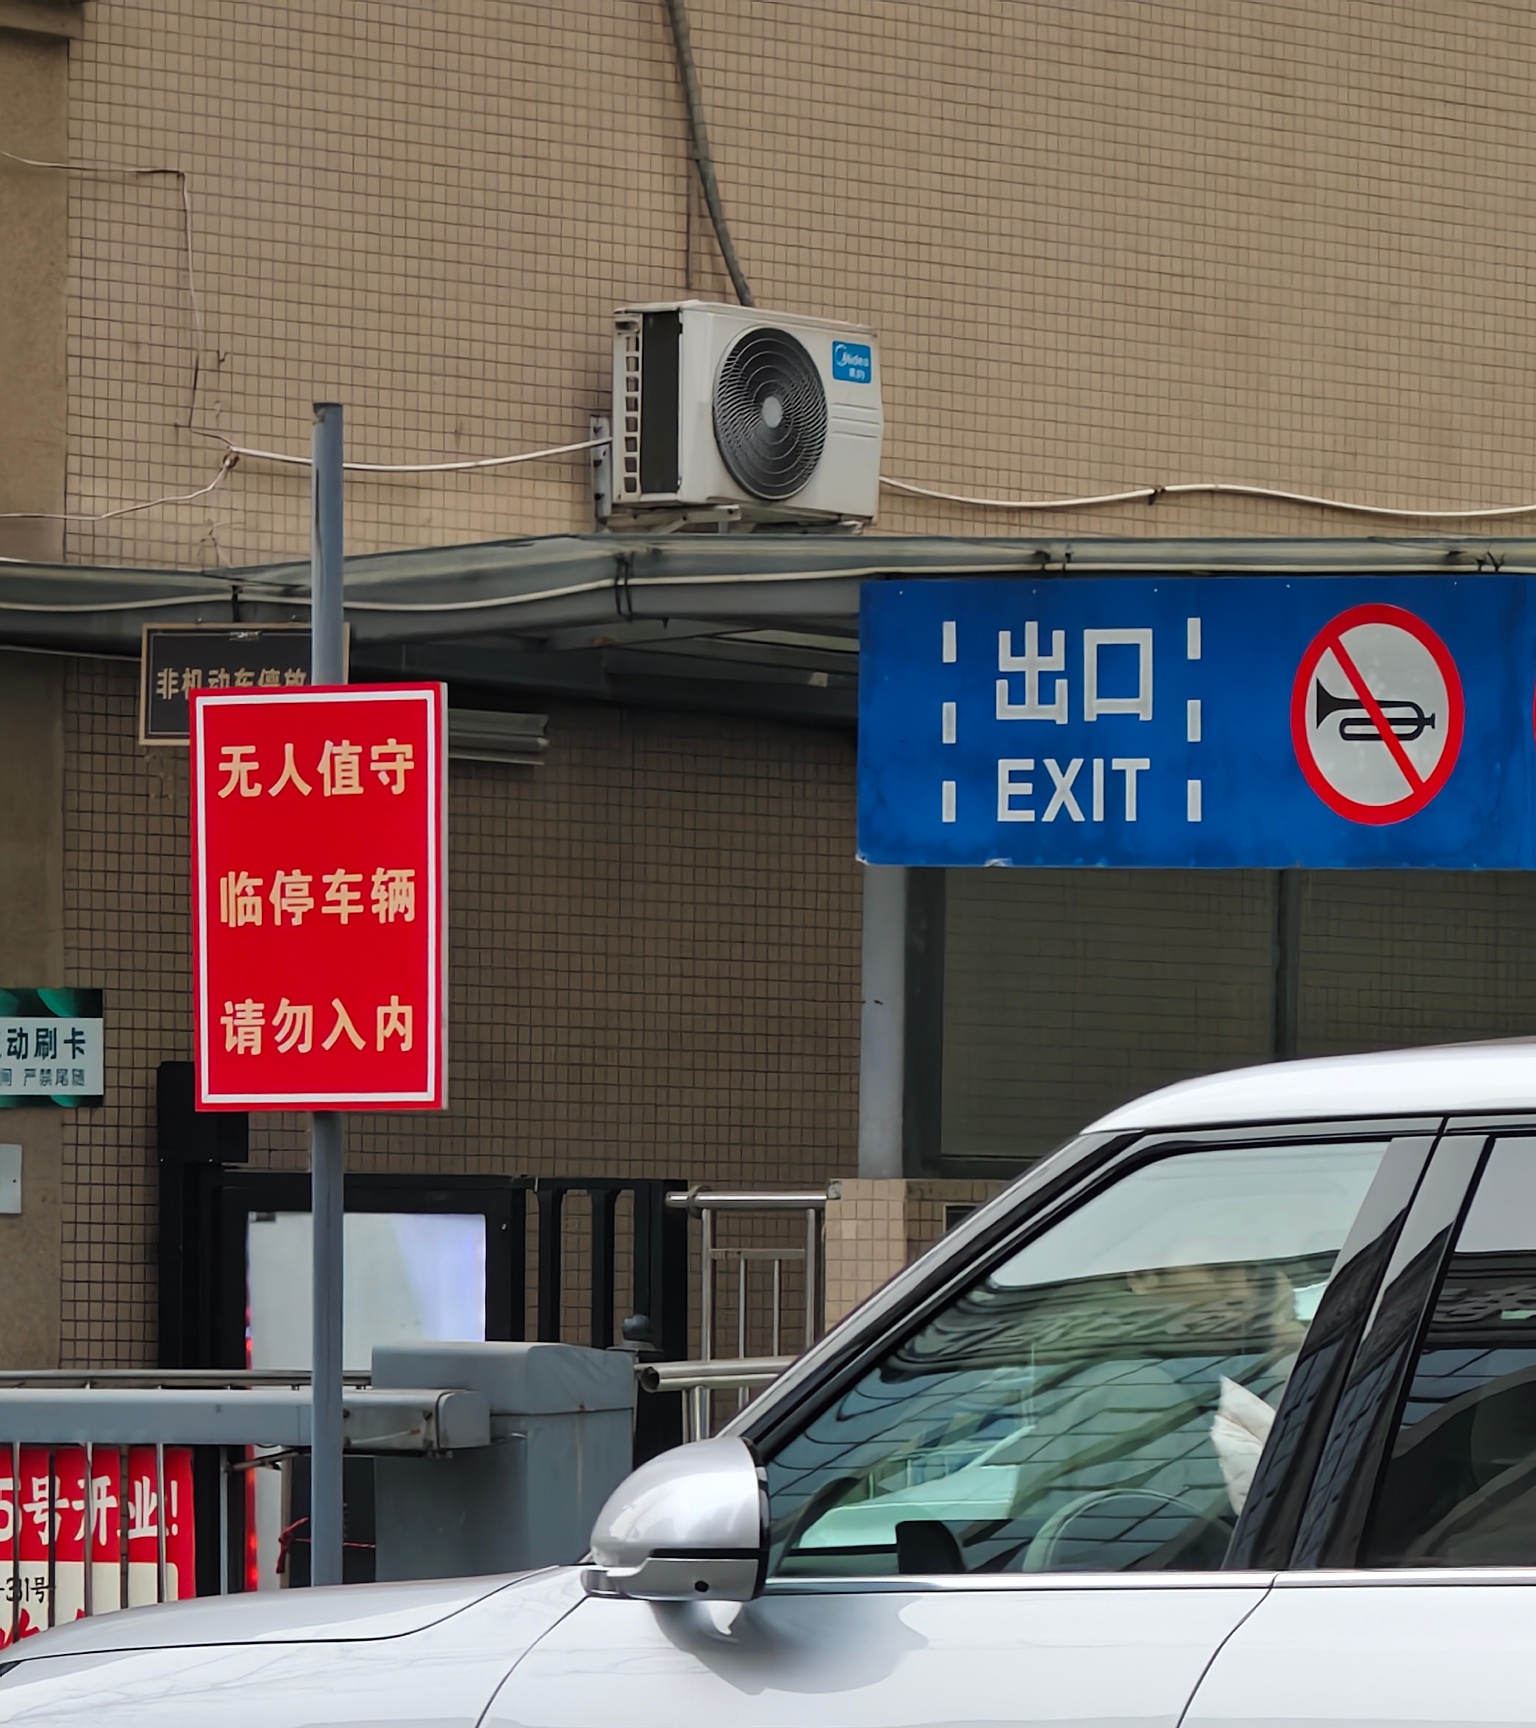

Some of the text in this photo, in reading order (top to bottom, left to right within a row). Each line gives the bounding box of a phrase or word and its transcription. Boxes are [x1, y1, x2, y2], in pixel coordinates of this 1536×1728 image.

[996, 621, 1153, 724] 出口
[217, 738, 415, 799] 无人值守
[997, 758, 1151, 822] EXIT
[219, 867, 416, 928] 临停车辆
[0, 1027, 86, 1060] 动刷卡
[220, 995, 414, 1055] 请勿入内
